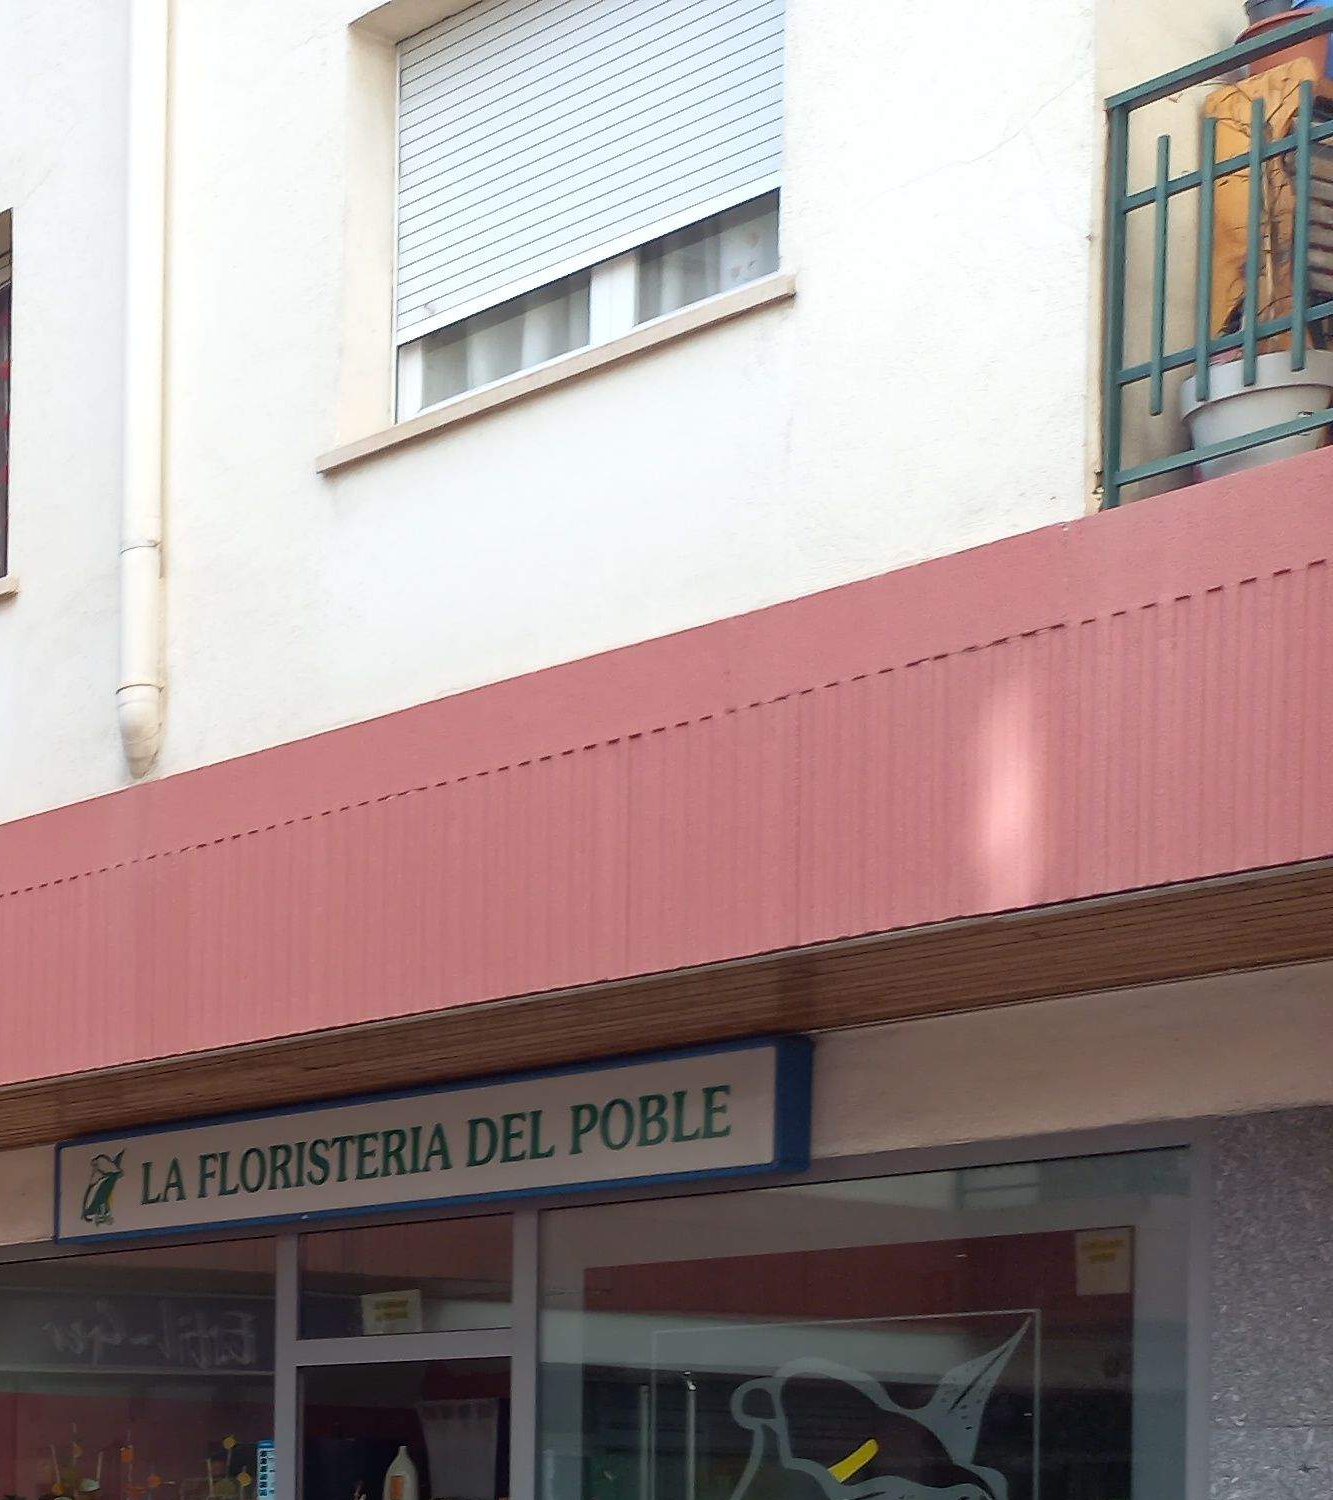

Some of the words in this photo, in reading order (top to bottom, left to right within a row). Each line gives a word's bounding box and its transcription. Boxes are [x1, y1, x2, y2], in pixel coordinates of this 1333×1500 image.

[141, 1156, 187, 1206] LA
[197, 1122, 453, 1199] FLORISTERIA
[466, 1109, 555, 1168] DEL
[569, 1084, 733, 1156] POBLE
